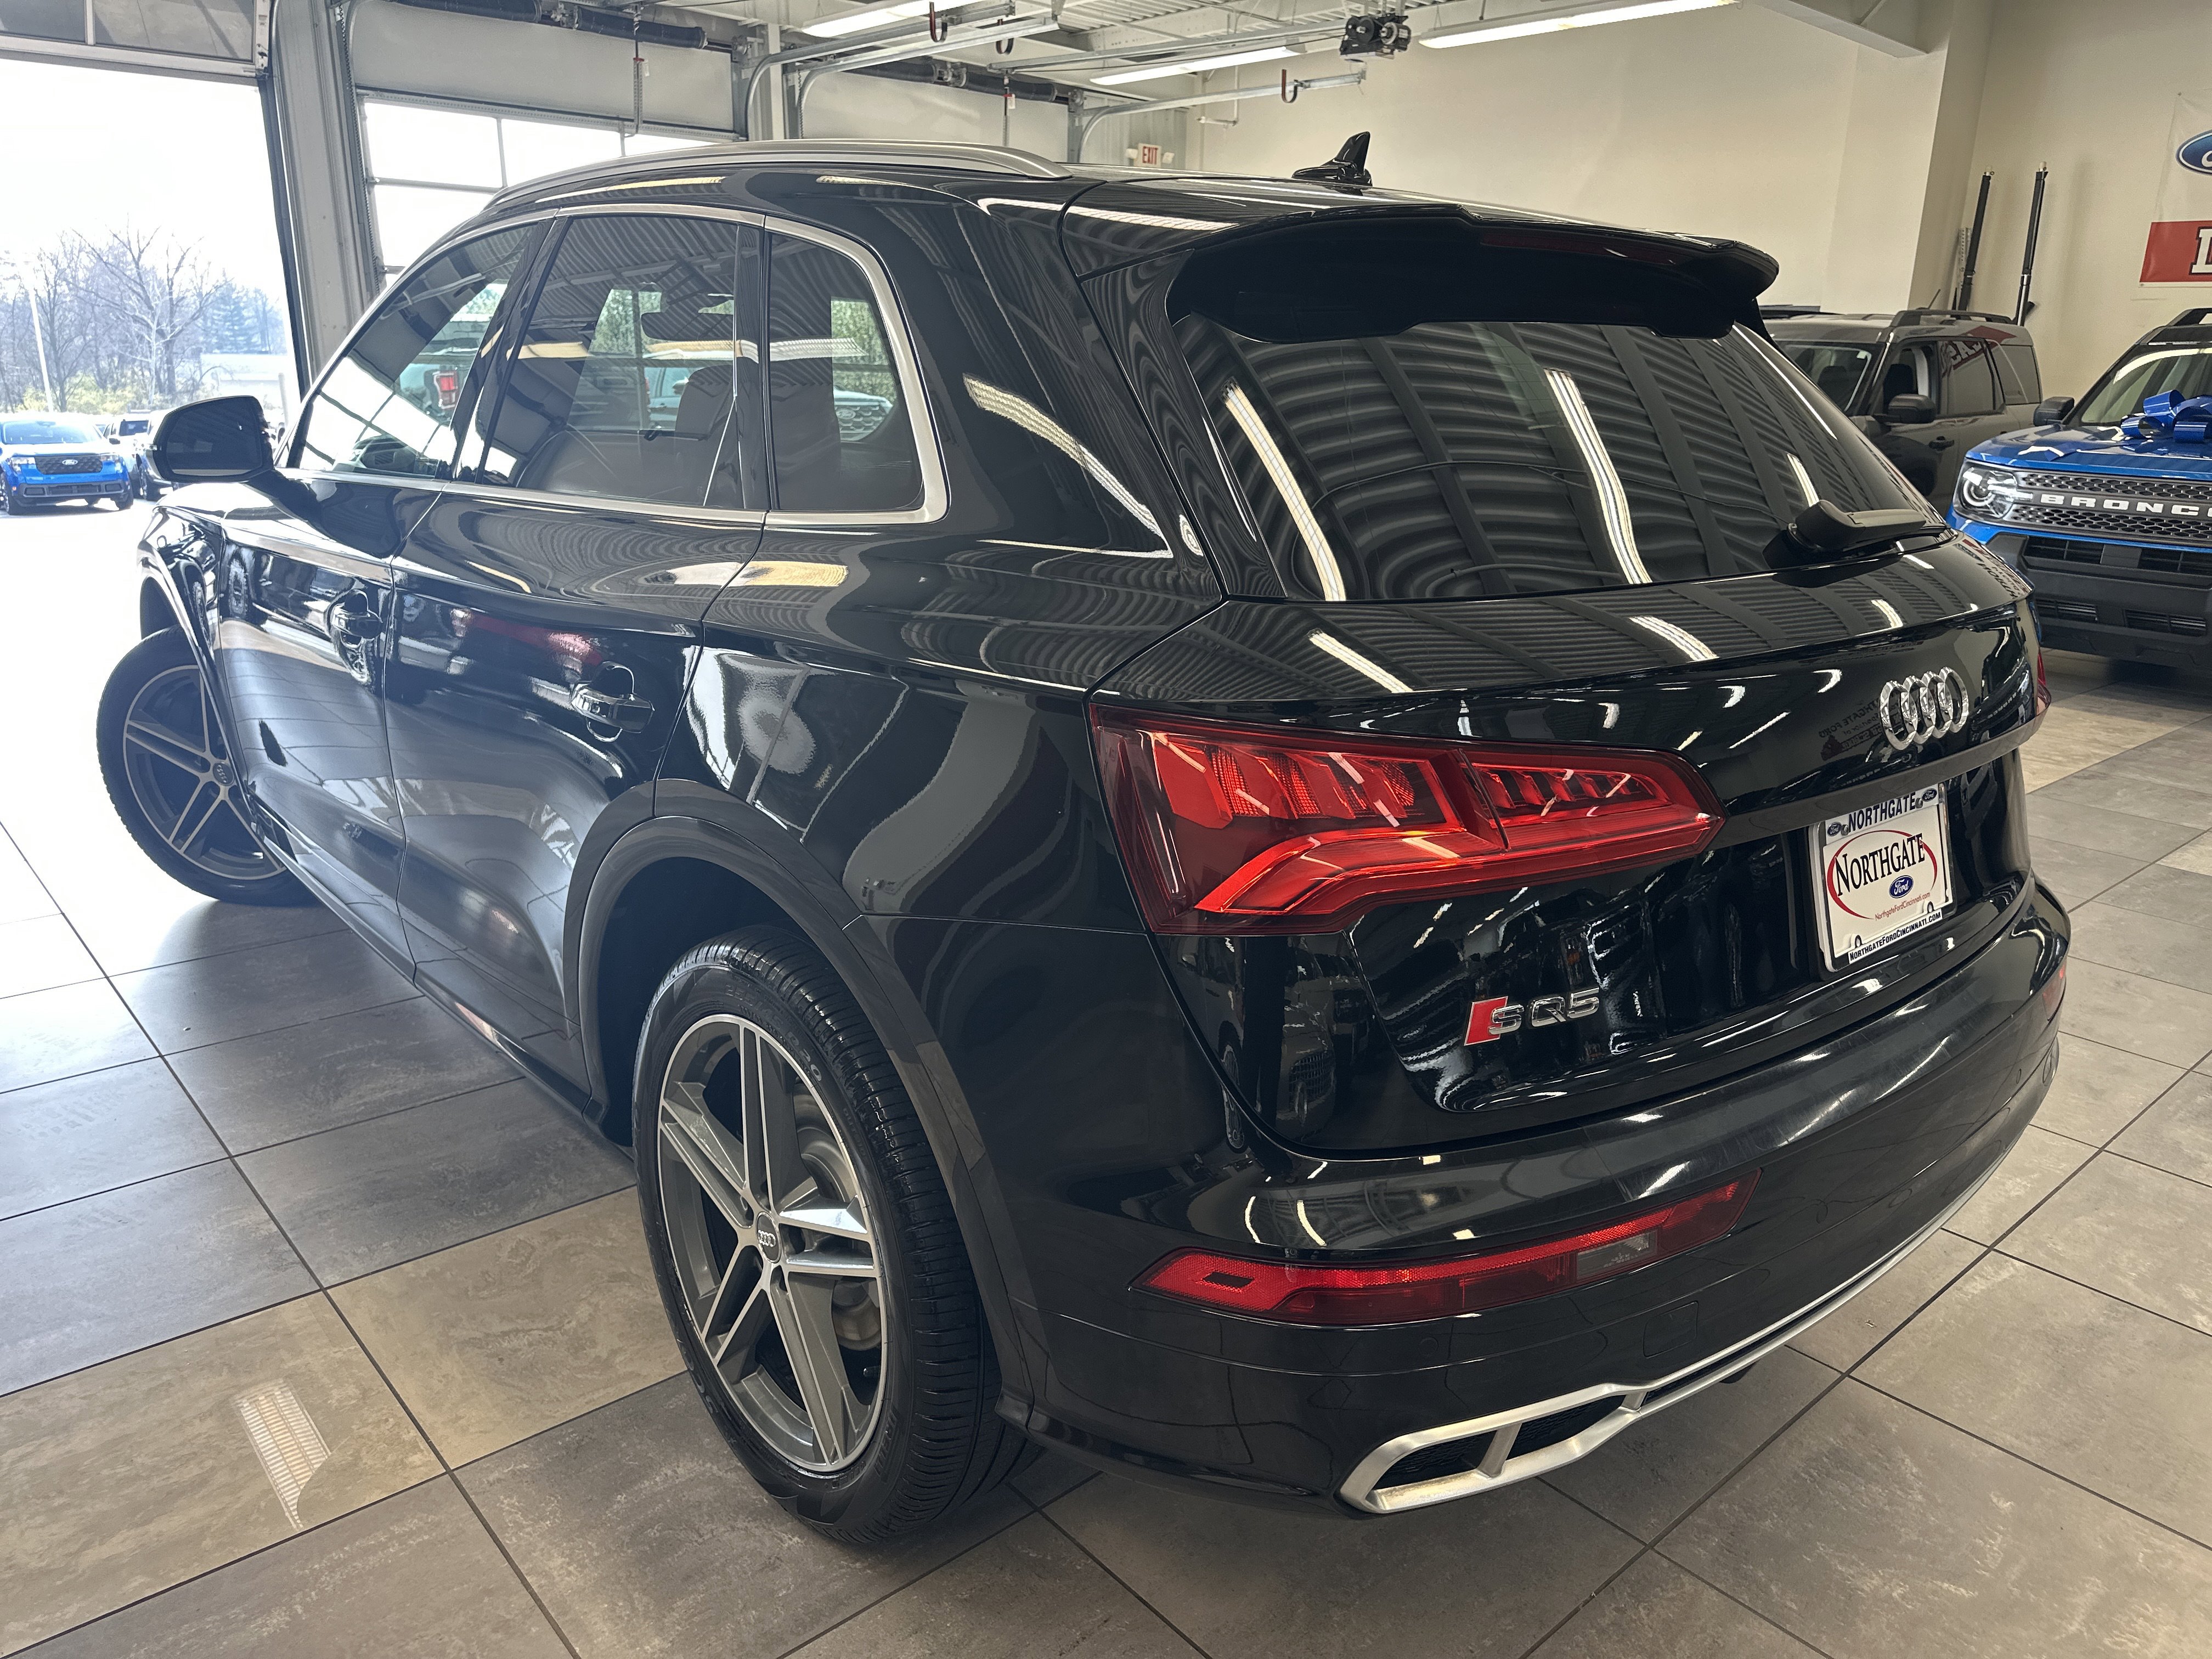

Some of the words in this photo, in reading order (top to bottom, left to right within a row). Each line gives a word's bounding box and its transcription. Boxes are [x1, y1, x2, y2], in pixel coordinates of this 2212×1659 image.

[1142, 146, 1159, 165] EXIT
[2040, 493, 2212, 517] BRONC
[1849, 792, 1916, 833] NORTHGATE
[1835, 833, 1925, 896] NORTHGATE
[1894, 879, 1909, 895] Ford
[1488, 987, 1600, 1035] SQ5
